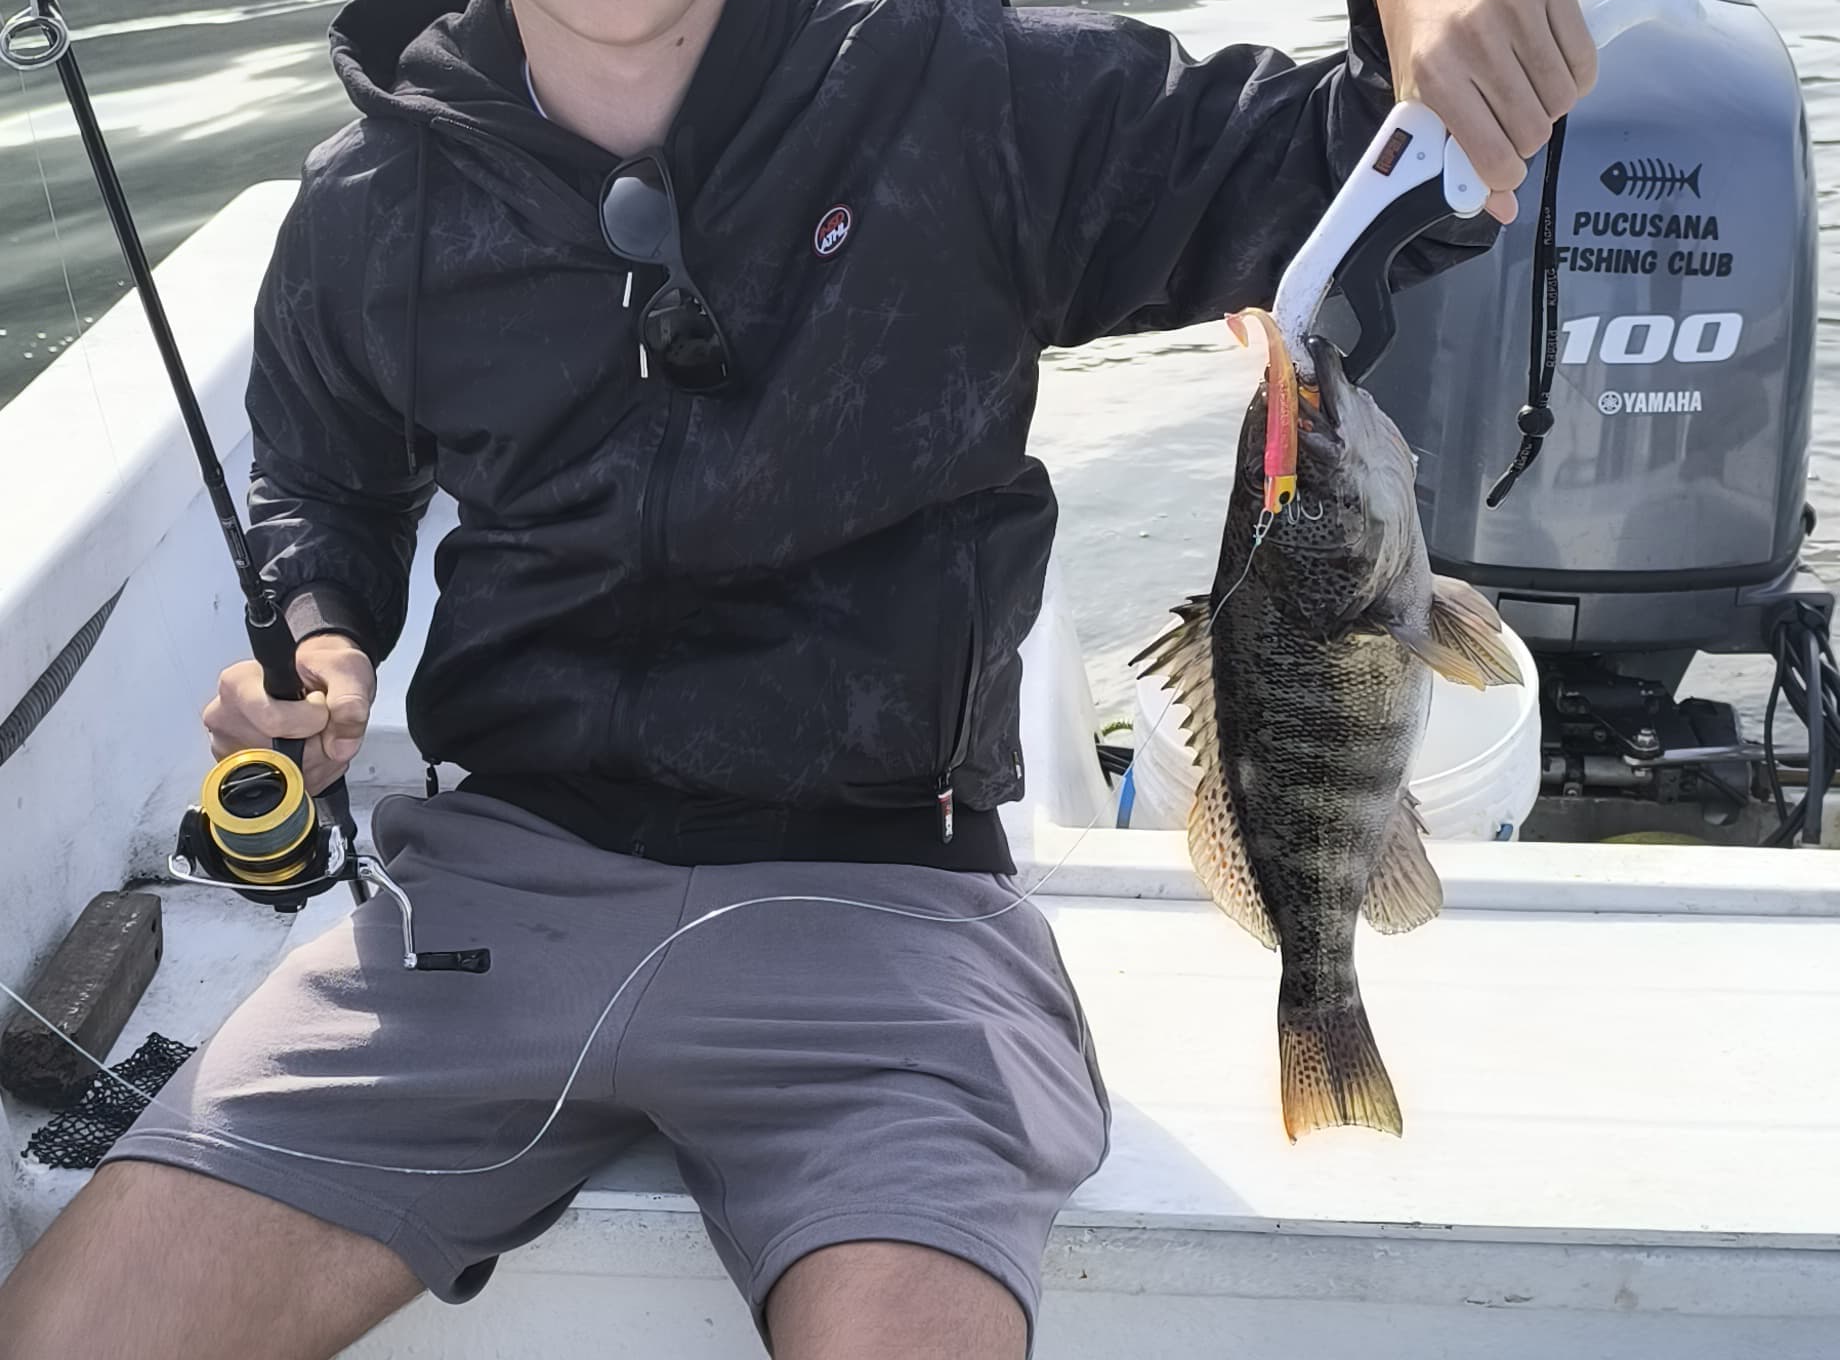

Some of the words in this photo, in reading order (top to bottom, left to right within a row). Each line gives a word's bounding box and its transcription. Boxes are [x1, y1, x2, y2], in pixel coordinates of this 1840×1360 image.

[1573, 211, 1719, 240] PUCUSANA
[1556, 246, 1658, 275] FISHING
[1668, 251, 1734, 277] CLUB
[1561, 312, 1744, 364] 100
[1624, 391, 1703, 414] YAMAHA
